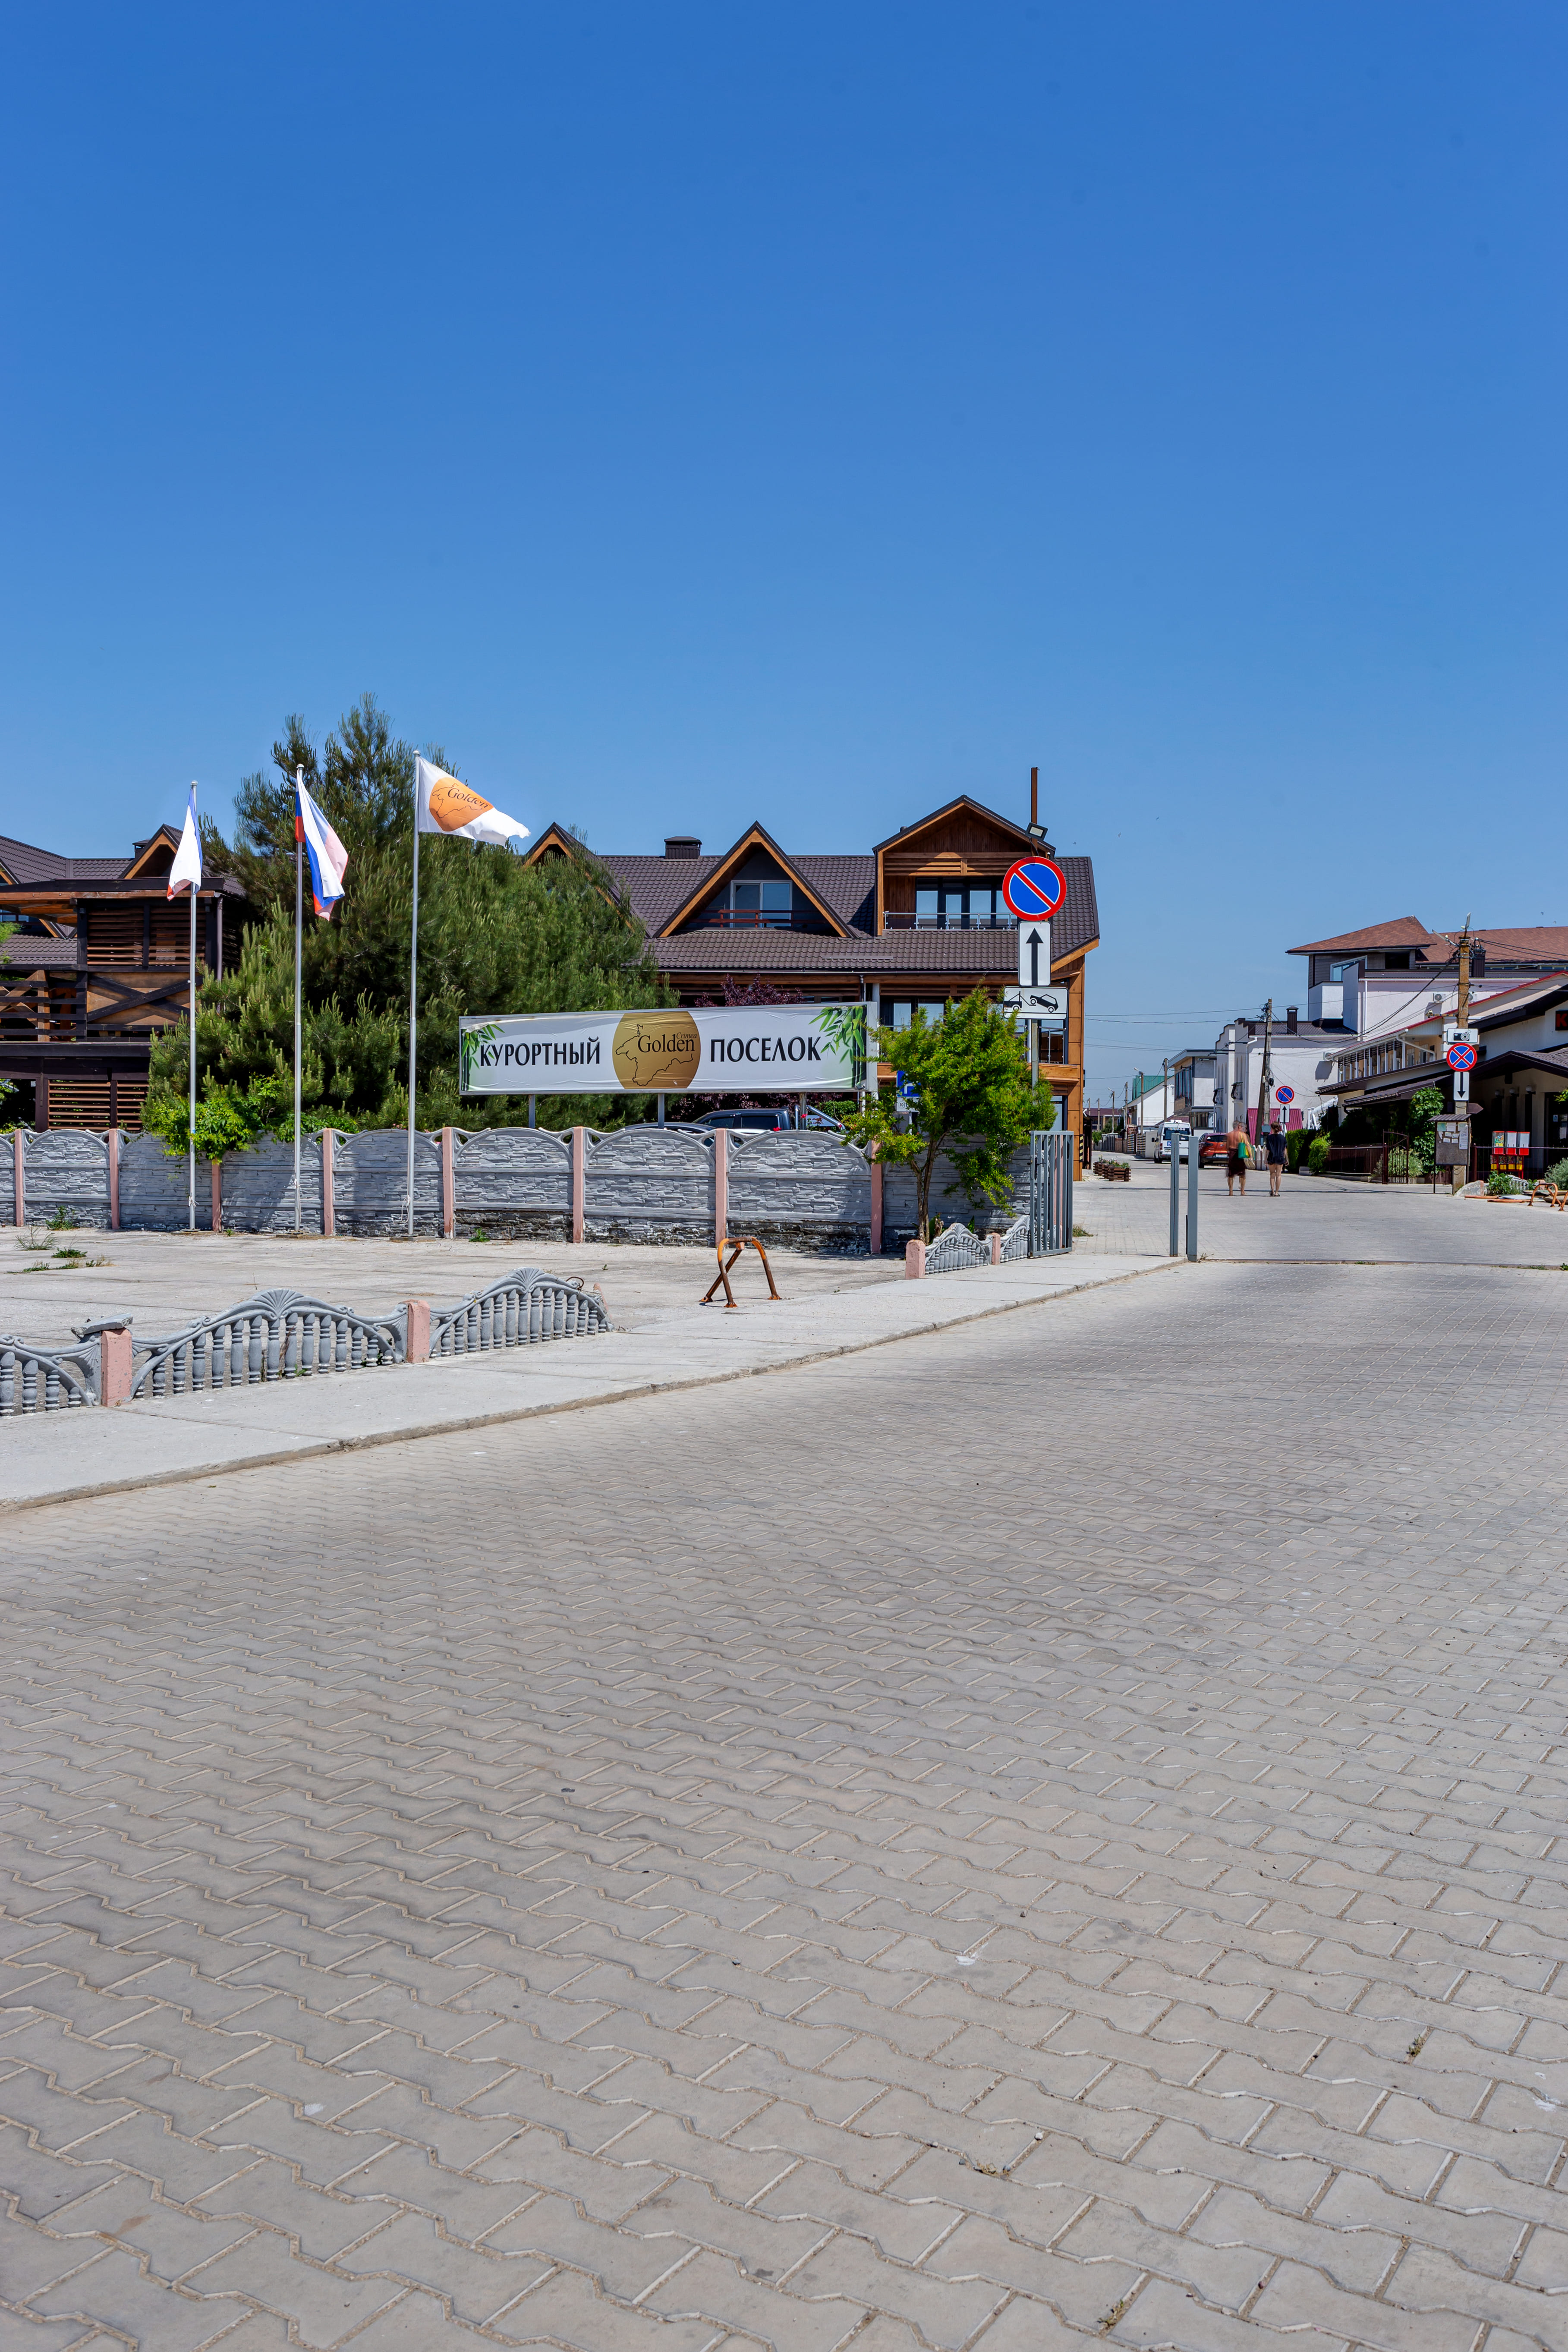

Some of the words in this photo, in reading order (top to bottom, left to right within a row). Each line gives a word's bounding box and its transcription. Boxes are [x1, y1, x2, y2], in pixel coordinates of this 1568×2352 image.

[447, 788, 488, 808] Golden
[480, 1036, 600, 1066] КУРОРТНЫЙ
[637, 1034, 696, 1053] Golden
[711, 1036, 821, 1062] ПОСЕЛОК
